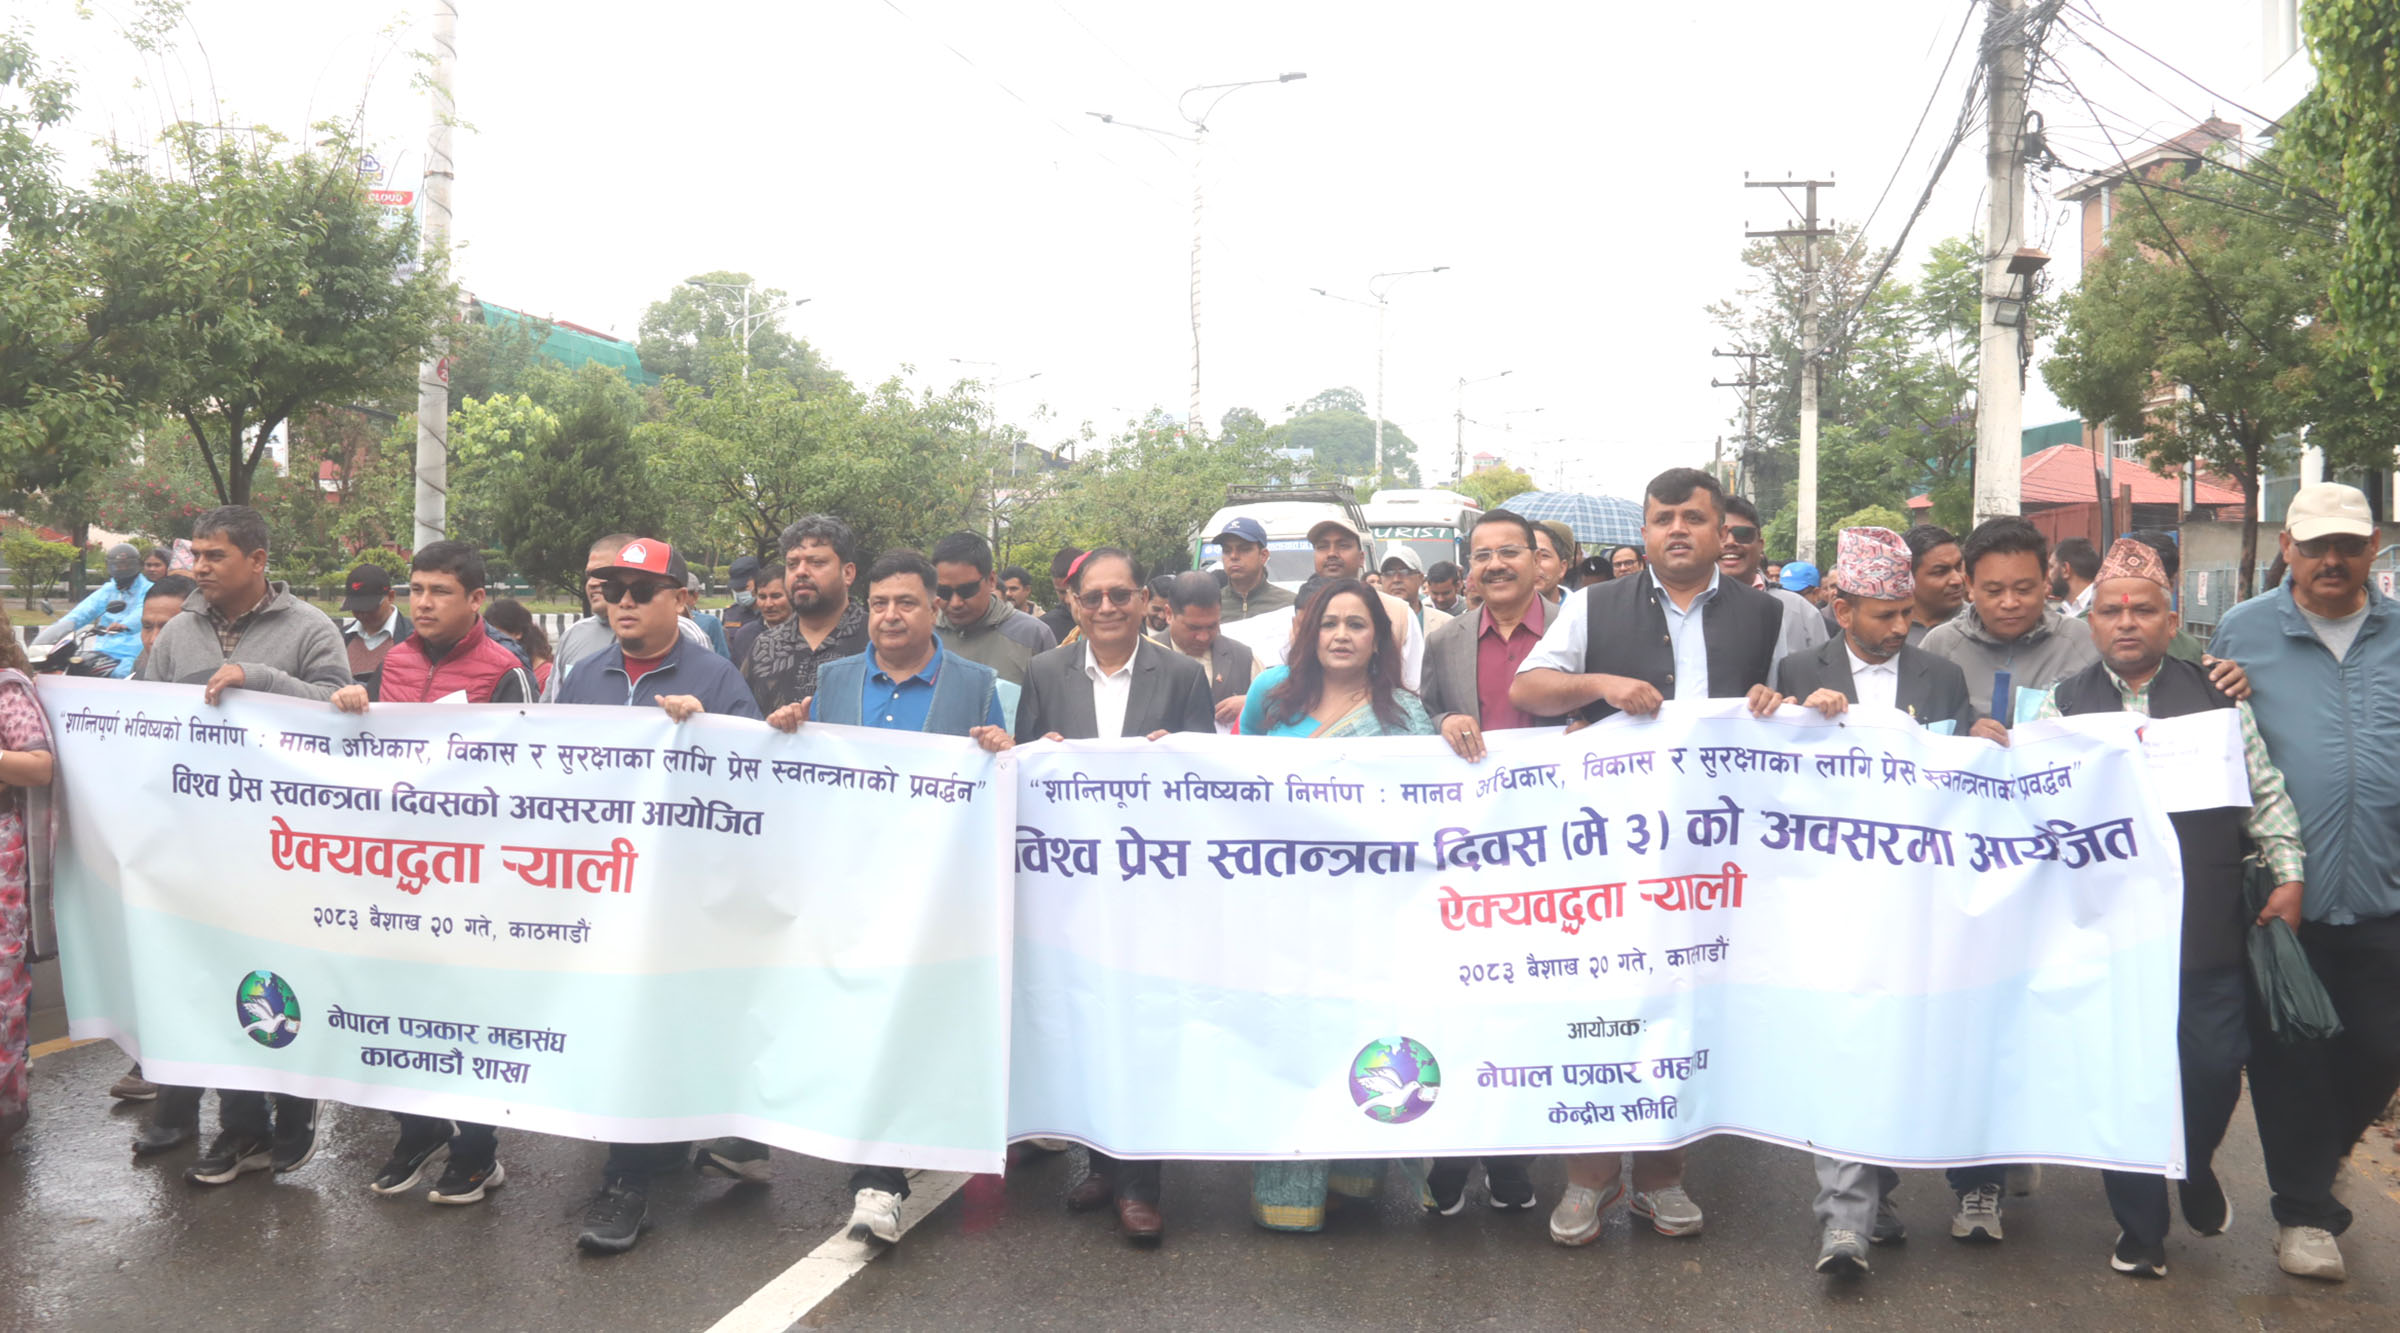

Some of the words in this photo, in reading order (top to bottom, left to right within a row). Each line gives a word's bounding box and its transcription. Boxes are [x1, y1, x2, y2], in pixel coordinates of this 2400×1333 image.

[61, 707, 120, 741] “शान्तिपूर्ण
[125, 712, 182, 740] भविष्यको
[189, 716, 248, 747] निर्माण
[280, 732, 331, 755] मानव
[342, 731, 430, 763] अधिकार,
[448, 733, 518, 766] विकास
[529, 744, 547, 768] र
[557, 745, 655, 775] सुरक्षाका
[663, 745, 717, 776] लागि
[727, 751, 762, 782] प्रेस
[772, 760, 899, 793] स्वतन्त्रताको
[1030, 772, 1151, 808] “शान्तिपूर्ण
[1162, 772, 1274, 802] भविष्यको
[1285, 774, 1364, 803] निर्माण
[1400, 783, 1463, 804] मानव
[1476, 763, 1564, 797] अधिकार,
[1583, 751, 1656, 780] विकास
[1668, 748, 1688, 774] र
[1699, 747, 1803, 778] सुरक्षाका
[1815, 747, 1873, 778] लागि
[1881, 752, 1916, 786] प्रेस
[172, 764, 221, 798] विश्व
[228, 769, 263, 802] प्रेस
[270, 780, 382, 811] स्वतन्त्रता
[392, 781, 500, 817] दिवसको
[509, 796, 635, 824] अवसरमा
[642, 796, 764, 836] आयोजित
[1015, 824, 1101, 877] विश्व
[1115, 826, 1191, 881] प्रेस
[1207, 839, 1422, 880] स्वतन्त्रता
[1431, 825, 1547, 872] दिवस
[1686, 795, 1744, 847] को
[1760, 810, 1955, 867] अवसरमा
[314, 907, 358, 930] २०८३
[370, 904, 422, 931] बैशाख
[431, 917, 453, 937] २०
[464, 915, 496, 941] गते,
[508, 918, 591, 943] काठमाडौं
[1460, 962, 1514, 986] २०८३
[1526, 953, 1579, 979] बैशाख
[1589, 956, 1608, 979] २०
[1617, 947, 1653, 974] गते,
[327, 1004, 390, 1035] नेपाल
[398, 1017, 480, 1044] पत्रकार
[488, 1026, 567, 1053] महासंघ
[472, 1057, 531, 1083] शाखा
[1477, 1061, 1553, 1088] नेपाल
[1562, 1062, 1642, 1086] पत्रकार
[1548, 1101, 1615, 1125] केन्द्रीय
[1620, 1095, 1678, 1122] समिति
